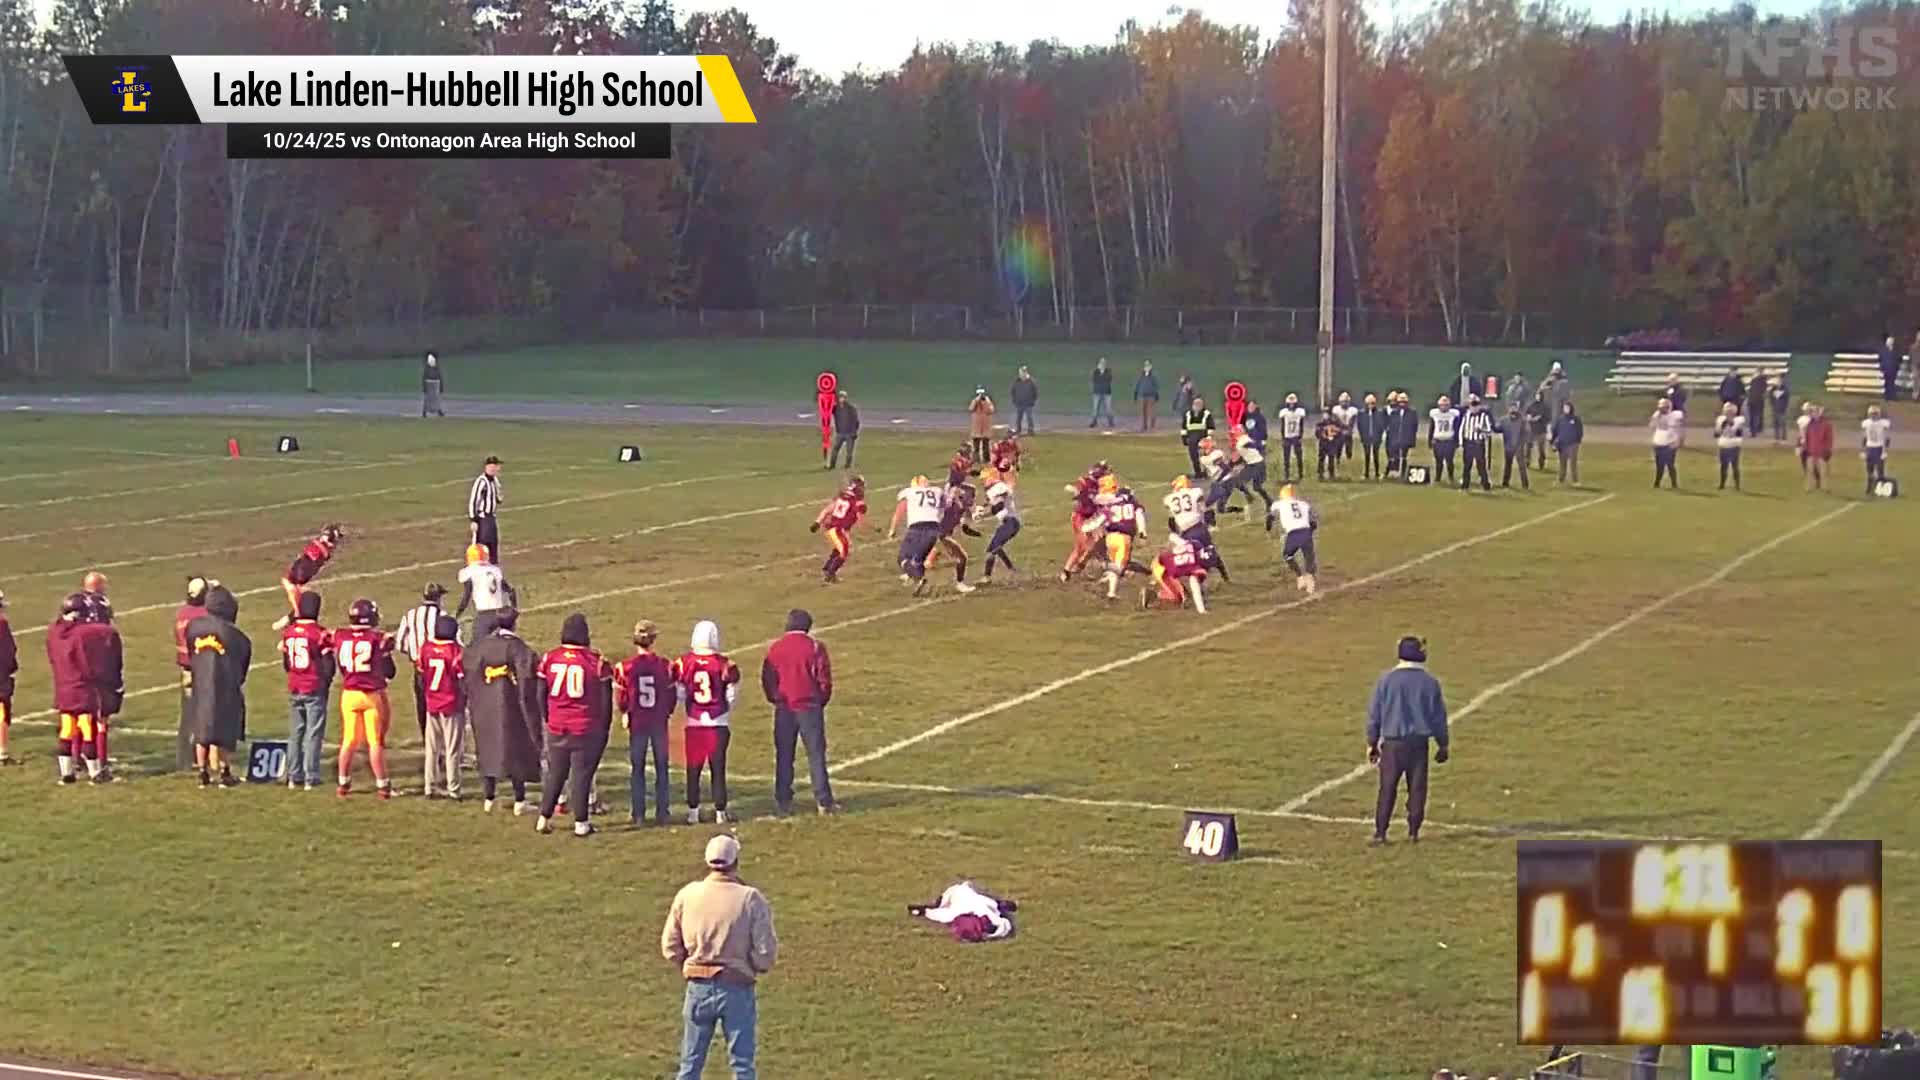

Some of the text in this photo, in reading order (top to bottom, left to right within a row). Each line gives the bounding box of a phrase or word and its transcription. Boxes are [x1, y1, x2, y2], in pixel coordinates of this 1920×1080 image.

[1408, 468, 1426, 483] 30
[915, 490, 937, 508] 79
[1171, 494, 1193, 514] 33
[1291, 502, 1302, 519] 5
[285, 637, 310, 669] 15
[339, 640, 372, 673] 42
[429, 658, 445, 691] 7
[550, 663, 584, 698] 70
[693, 670, 713, 704] 3
[638, 675, 656, 708] 5
[252, 748, 287, 778] 30
[1183, 820, 1224, 857] 40
